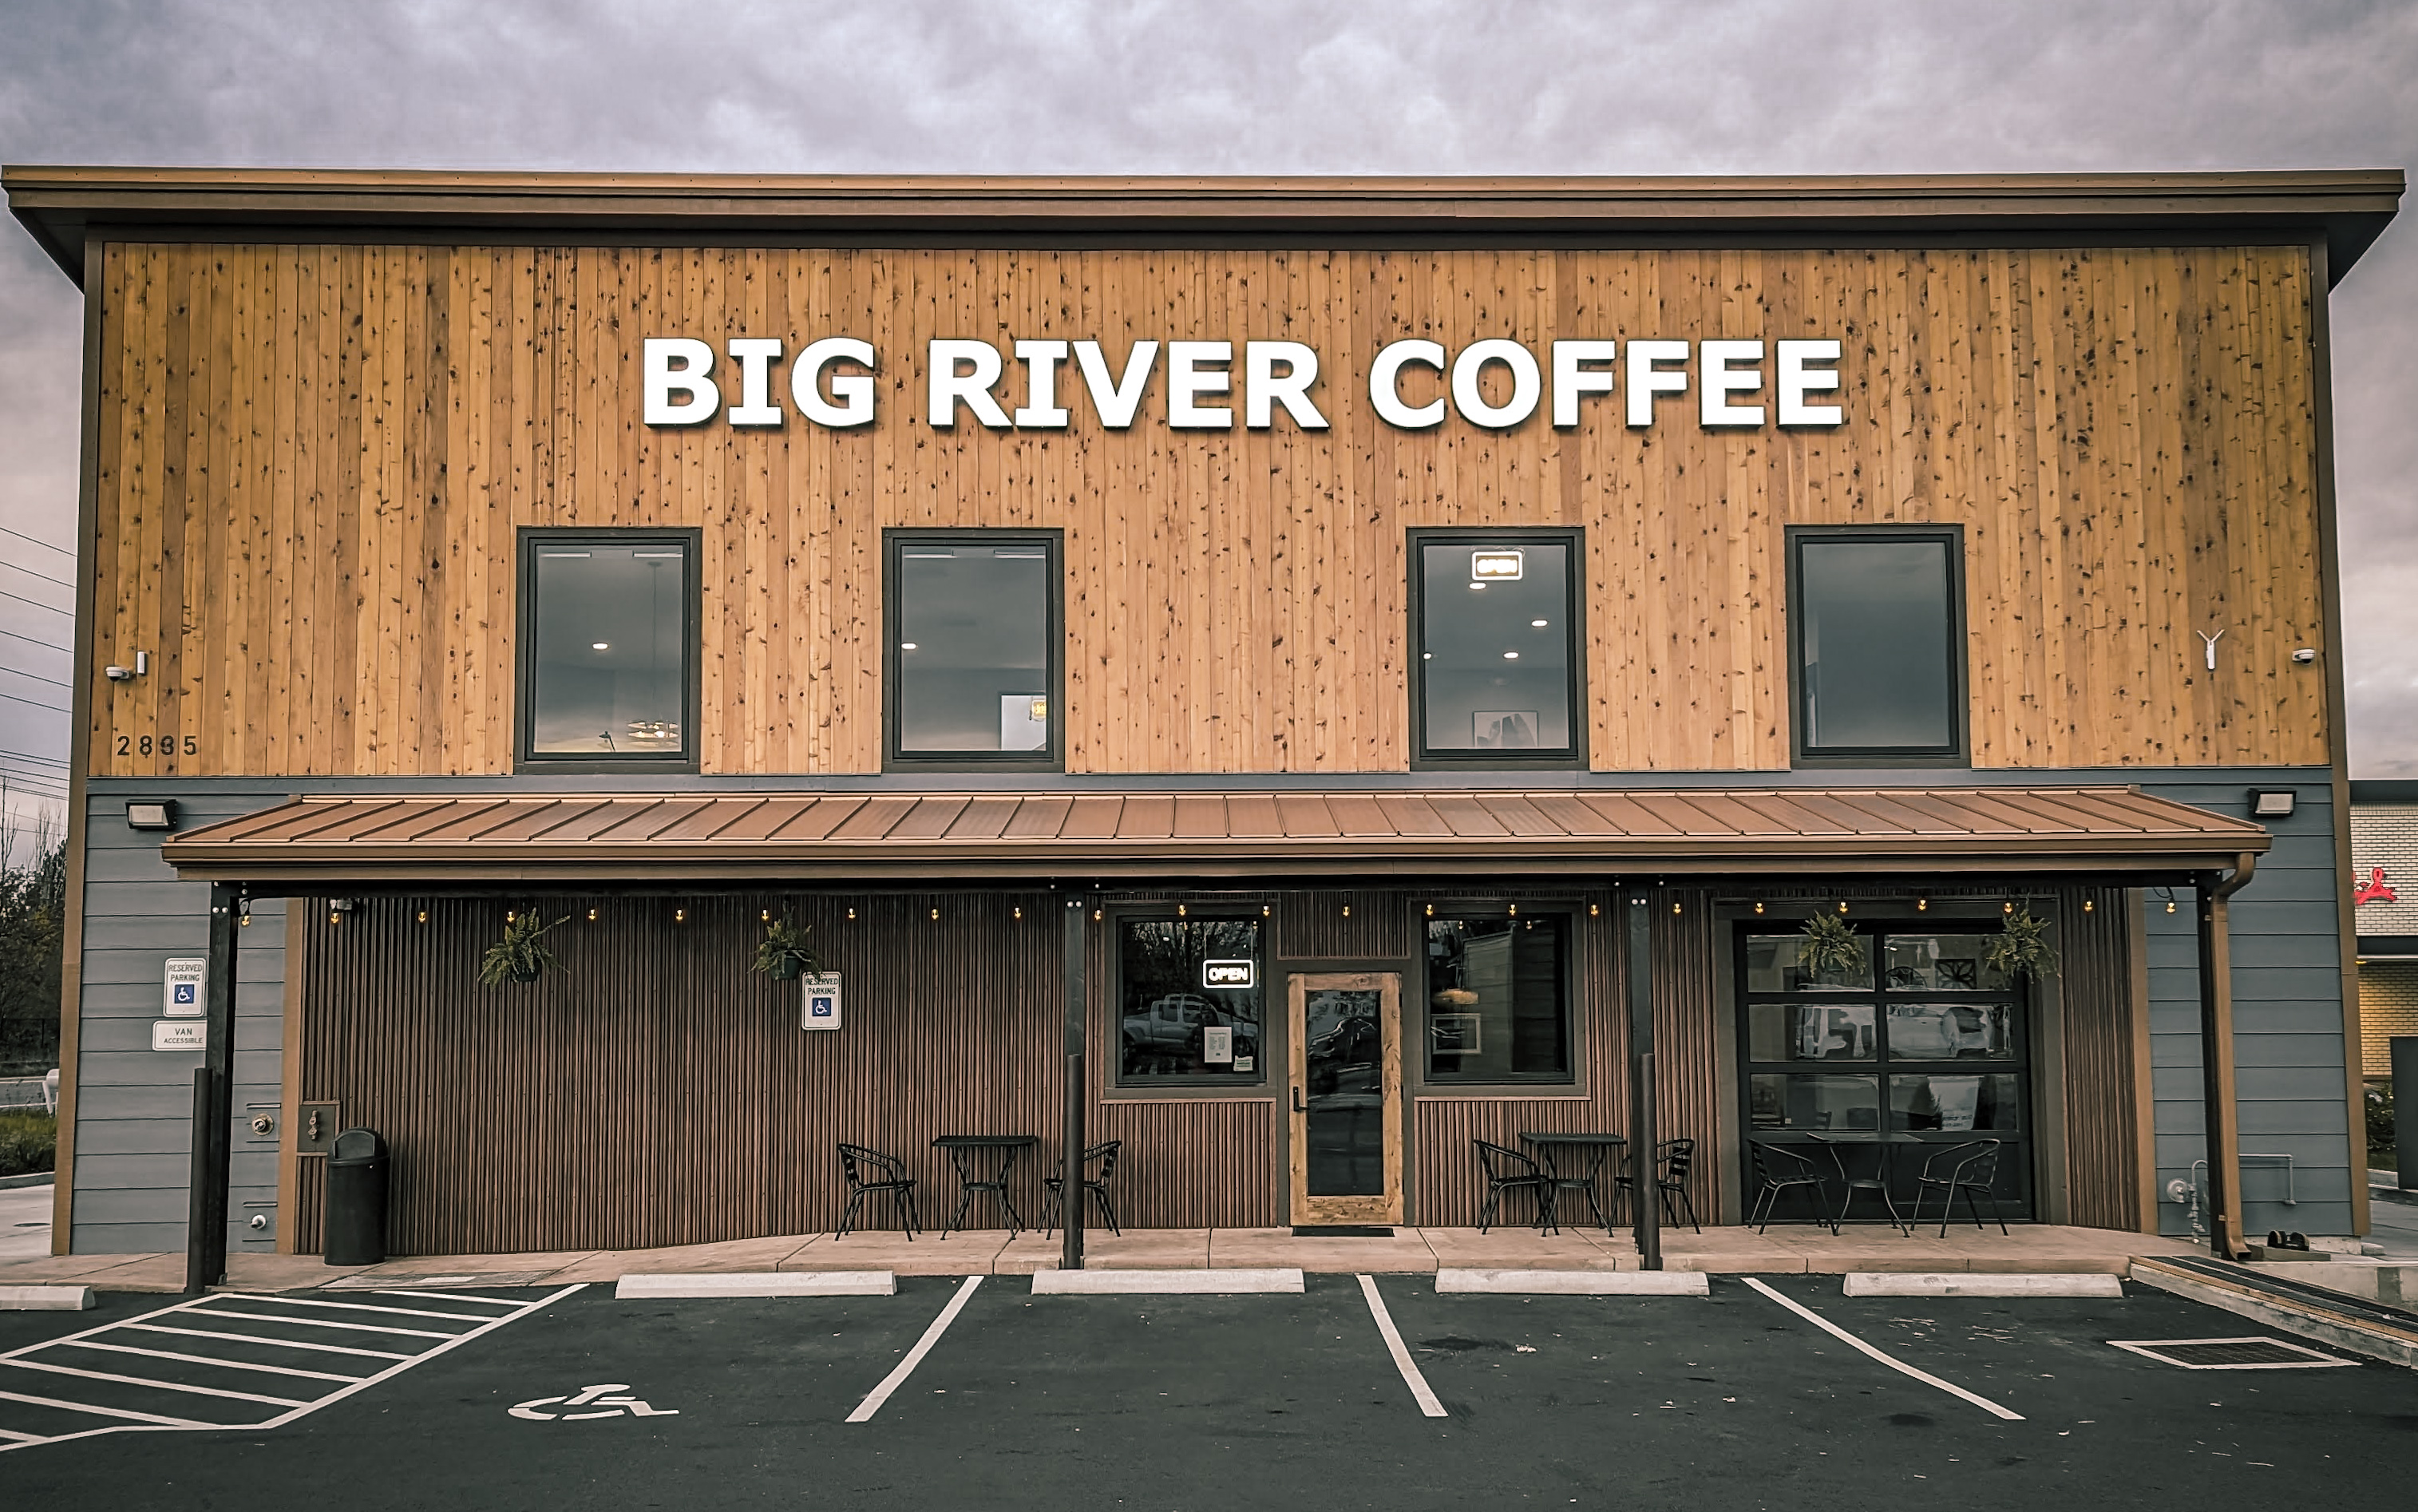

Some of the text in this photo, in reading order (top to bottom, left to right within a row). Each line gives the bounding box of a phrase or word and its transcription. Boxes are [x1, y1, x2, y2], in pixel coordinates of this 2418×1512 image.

[643, 338, 1843, 429] BIG RIVER COFFEE
[168, 964, 203, 972] RESERVED
[1208, 967, 1249, 982] OPEN
[175, 1027, 193, 1036] VAN
